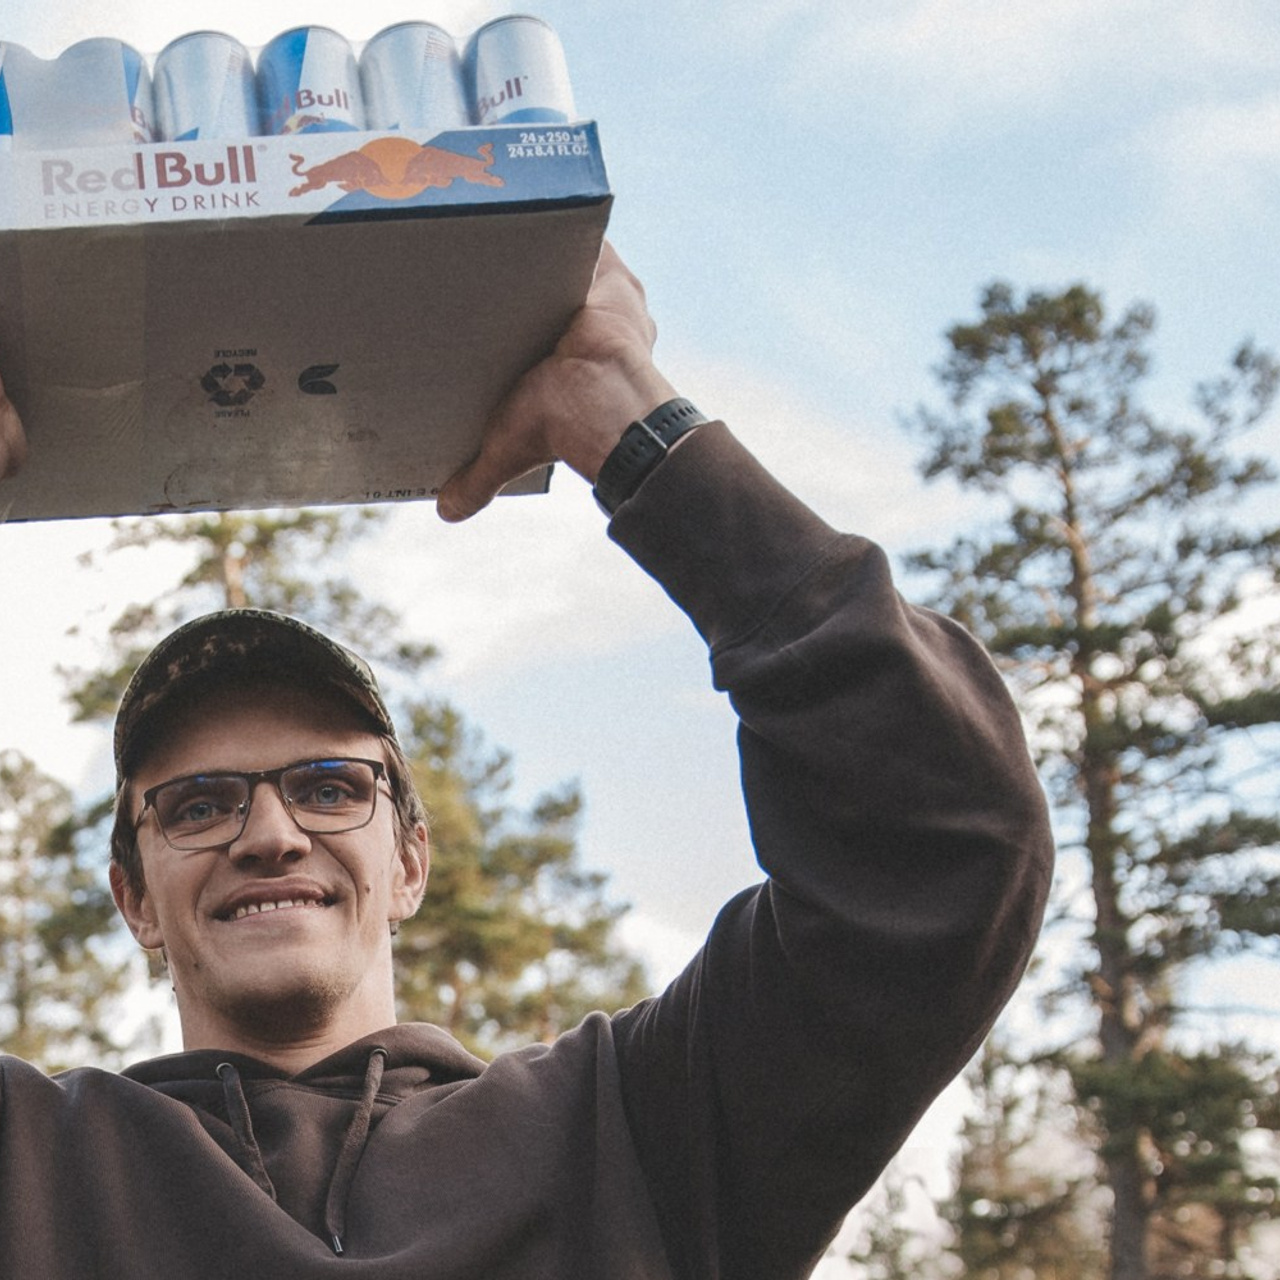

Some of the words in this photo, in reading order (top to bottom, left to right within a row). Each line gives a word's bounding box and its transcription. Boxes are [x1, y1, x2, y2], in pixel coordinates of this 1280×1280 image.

[295, 88, 349, 110] Bull
[41, 152, 145, 196] Red
[154, 144, 257, 189] Bull
[43, 198, 159, 219] ENERGY
[172, 191, 261, 212] DRINK
[214, 348, 257, 358] RECYCLE
